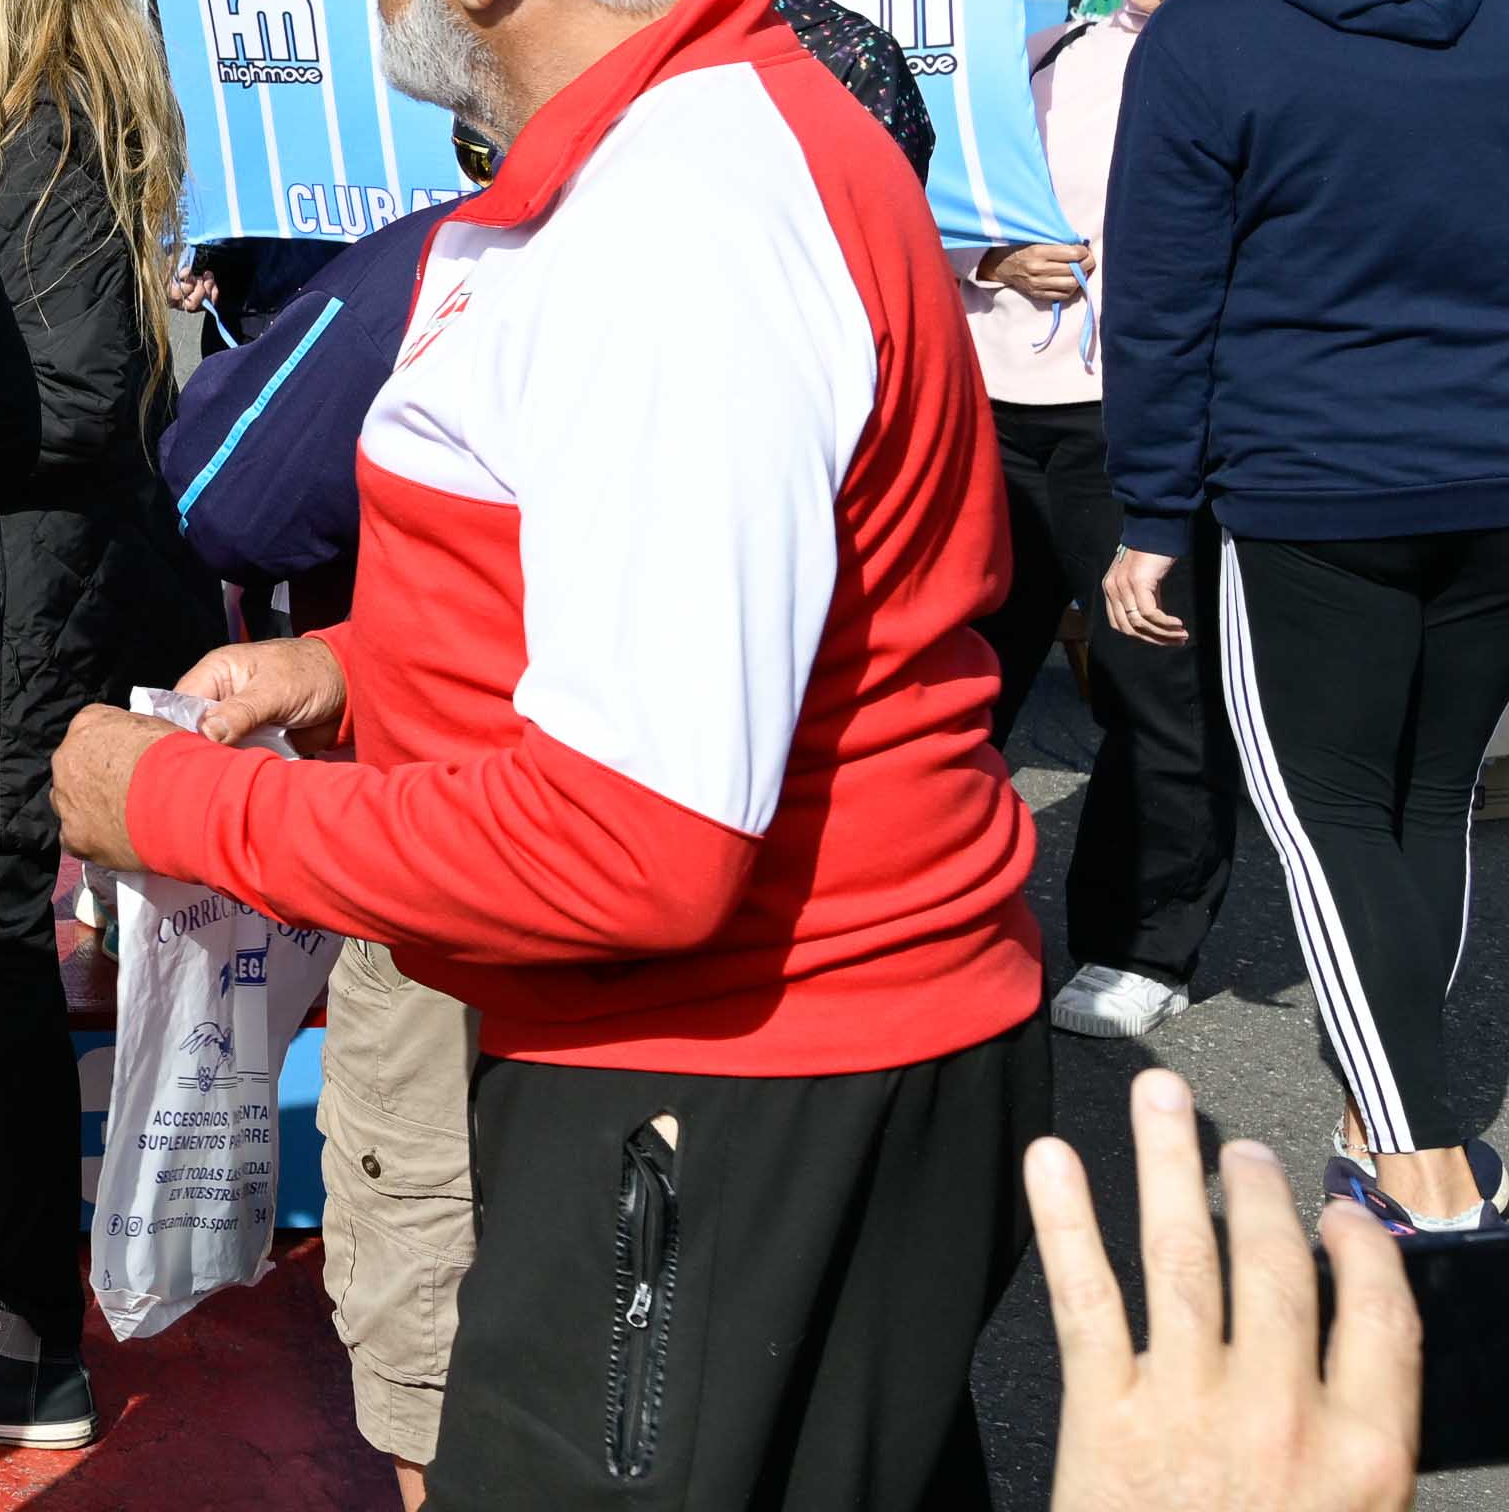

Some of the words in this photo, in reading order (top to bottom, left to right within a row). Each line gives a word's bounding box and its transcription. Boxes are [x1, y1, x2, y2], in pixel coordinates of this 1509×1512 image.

[217, 61, 323, 89] highmove
[153, 1110, 230, 1128] ACCESORIOS,
[138, 1134, 226, 1151] SUPLEMENTOS
